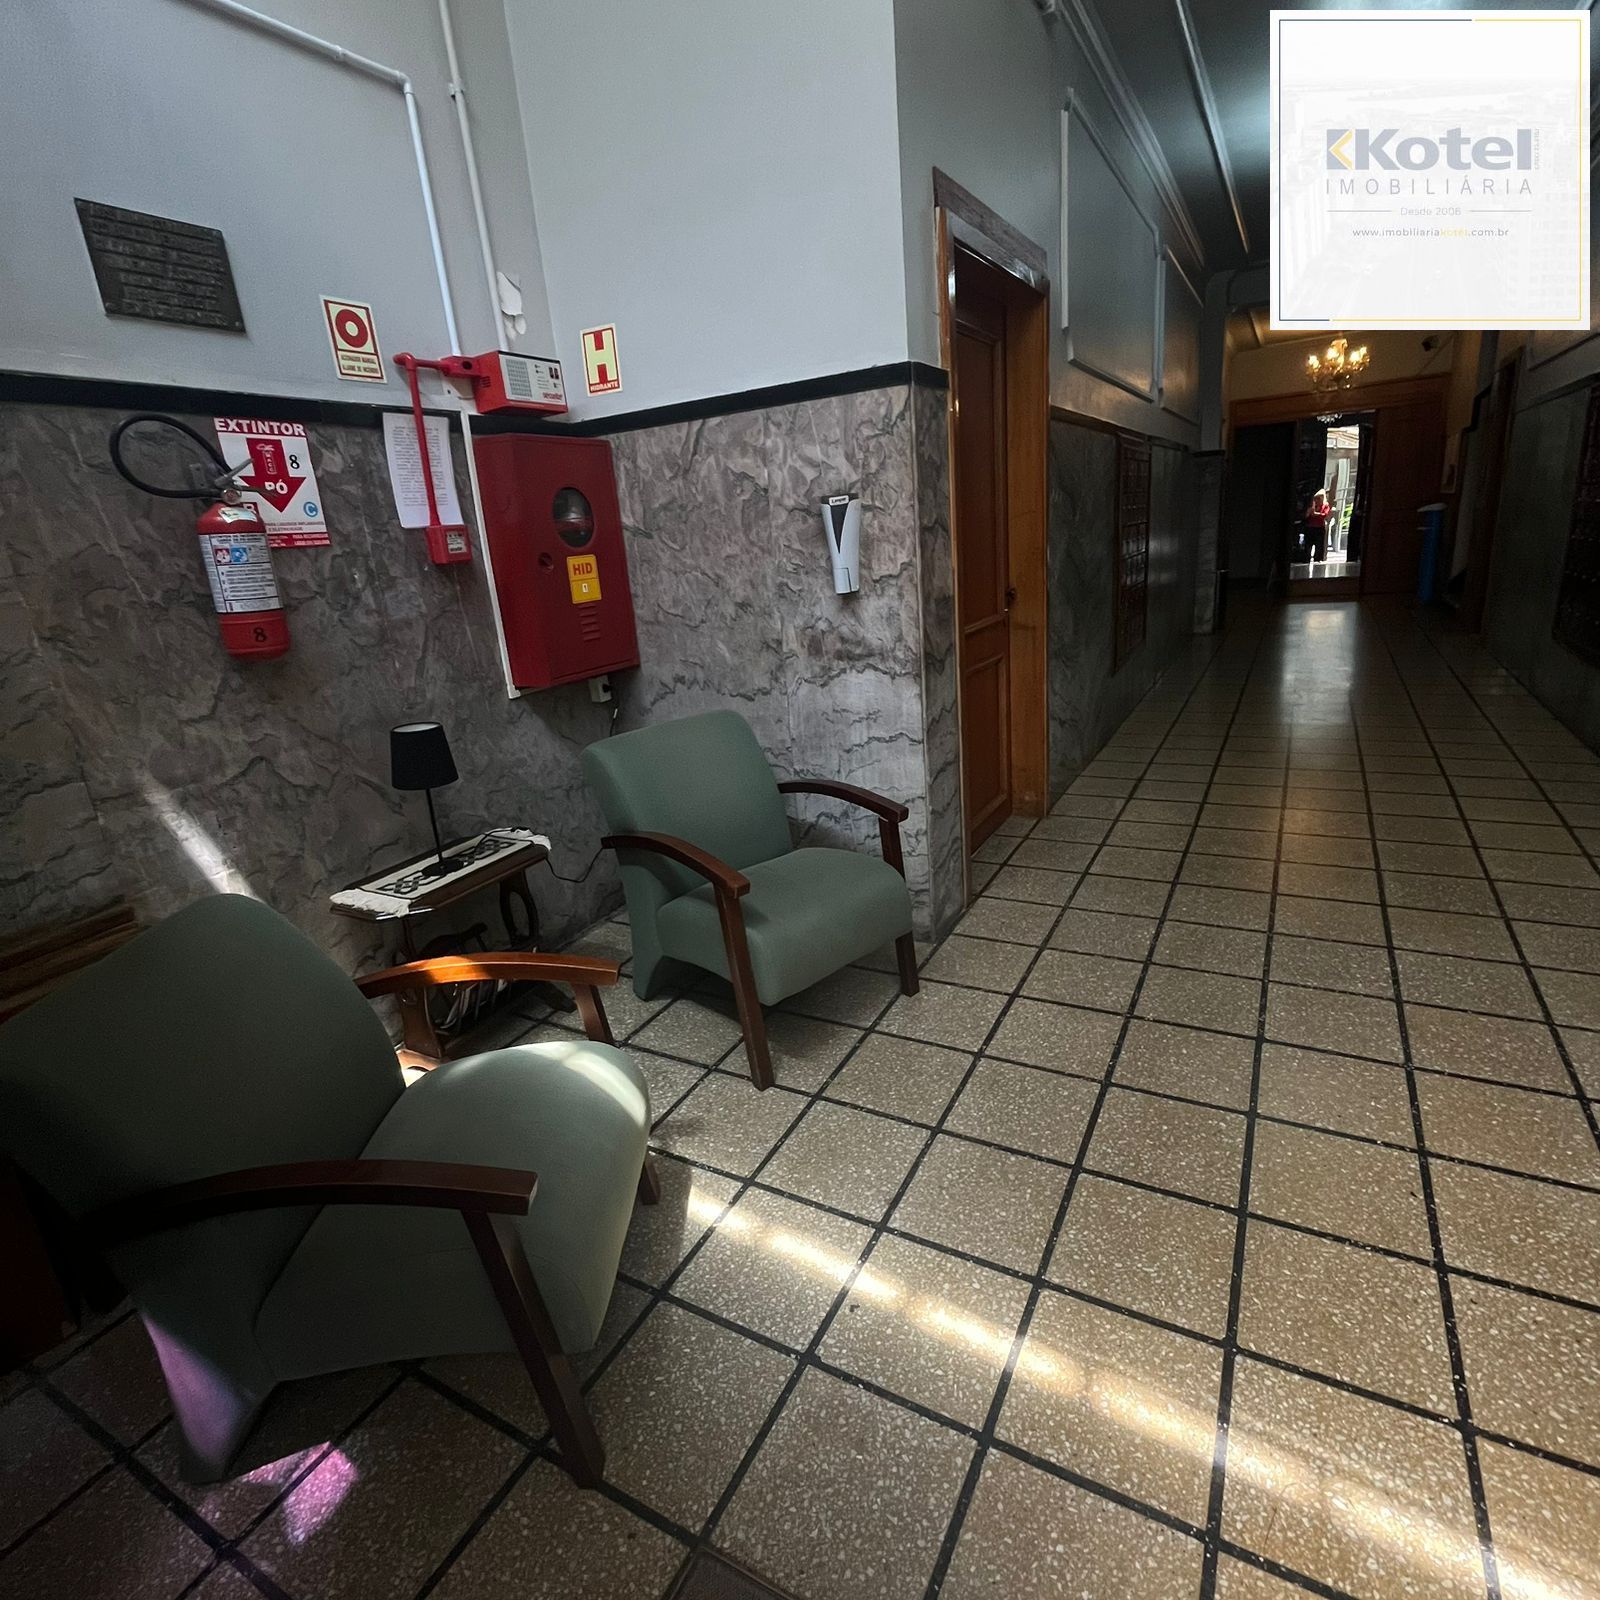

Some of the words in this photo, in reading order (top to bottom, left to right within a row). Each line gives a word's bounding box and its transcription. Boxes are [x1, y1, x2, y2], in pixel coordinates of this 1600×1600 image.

[213, 417, 306, 436] EXTINTOR
[289, 454, 300, 469] 8
[572, 562, 593, 576] HID
[253, 627, 266, 643] 8
